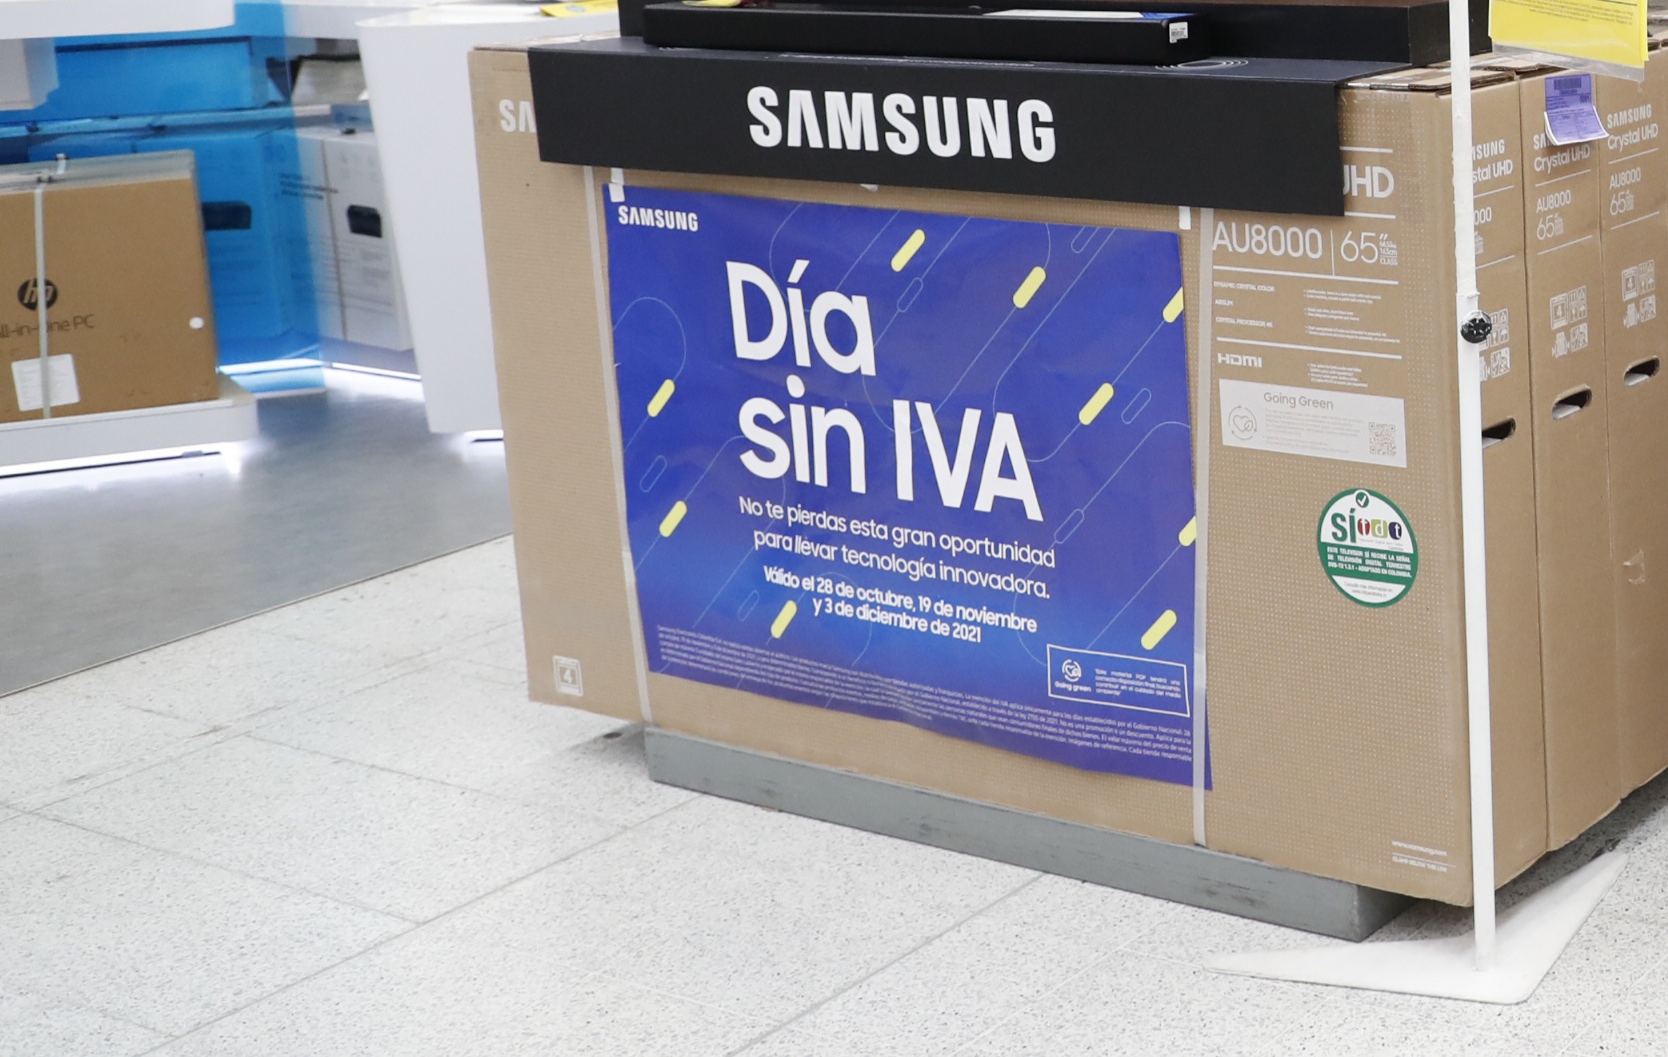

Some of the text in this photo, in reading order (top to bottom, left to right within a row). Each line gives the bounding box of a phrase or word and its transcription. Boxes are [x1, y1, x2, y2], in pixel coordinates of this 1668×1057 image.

[746, 85, 1056, 163] SAMSUNG
[1607, 104, 1652, 129] SAMSUNG
[1608, 123, 1658, 152] Crystal UHD
[1534, 144, 1590, 174] Crystal UHD
[1609, 167, 1641, 190] AU8000
[618, 205, 699, 232] SAMSUNG
[1536, 190, 1571, 214] AU8000
[1212, 221, 1323, 259] AU8000
[726, 259, 876, 377] Día
[1217, 352, 1263, 368] HDMI
[1263, 392, 1334, 410] Going Green
[738, 374, 1044, 523] sin IVA
[739, 496, 1056, 568] No te pierdas esta gran oportunidad
[1331, 508, 1356, 543] SÍ
[754, 530, 1051, 599] para llevar tecnología innovadora.
[763, 565, 1038, 633] Válido el 28 de octubre, 19 de noviembre
[813, 597, 982, 643] y 3 de diciembre de 2021
